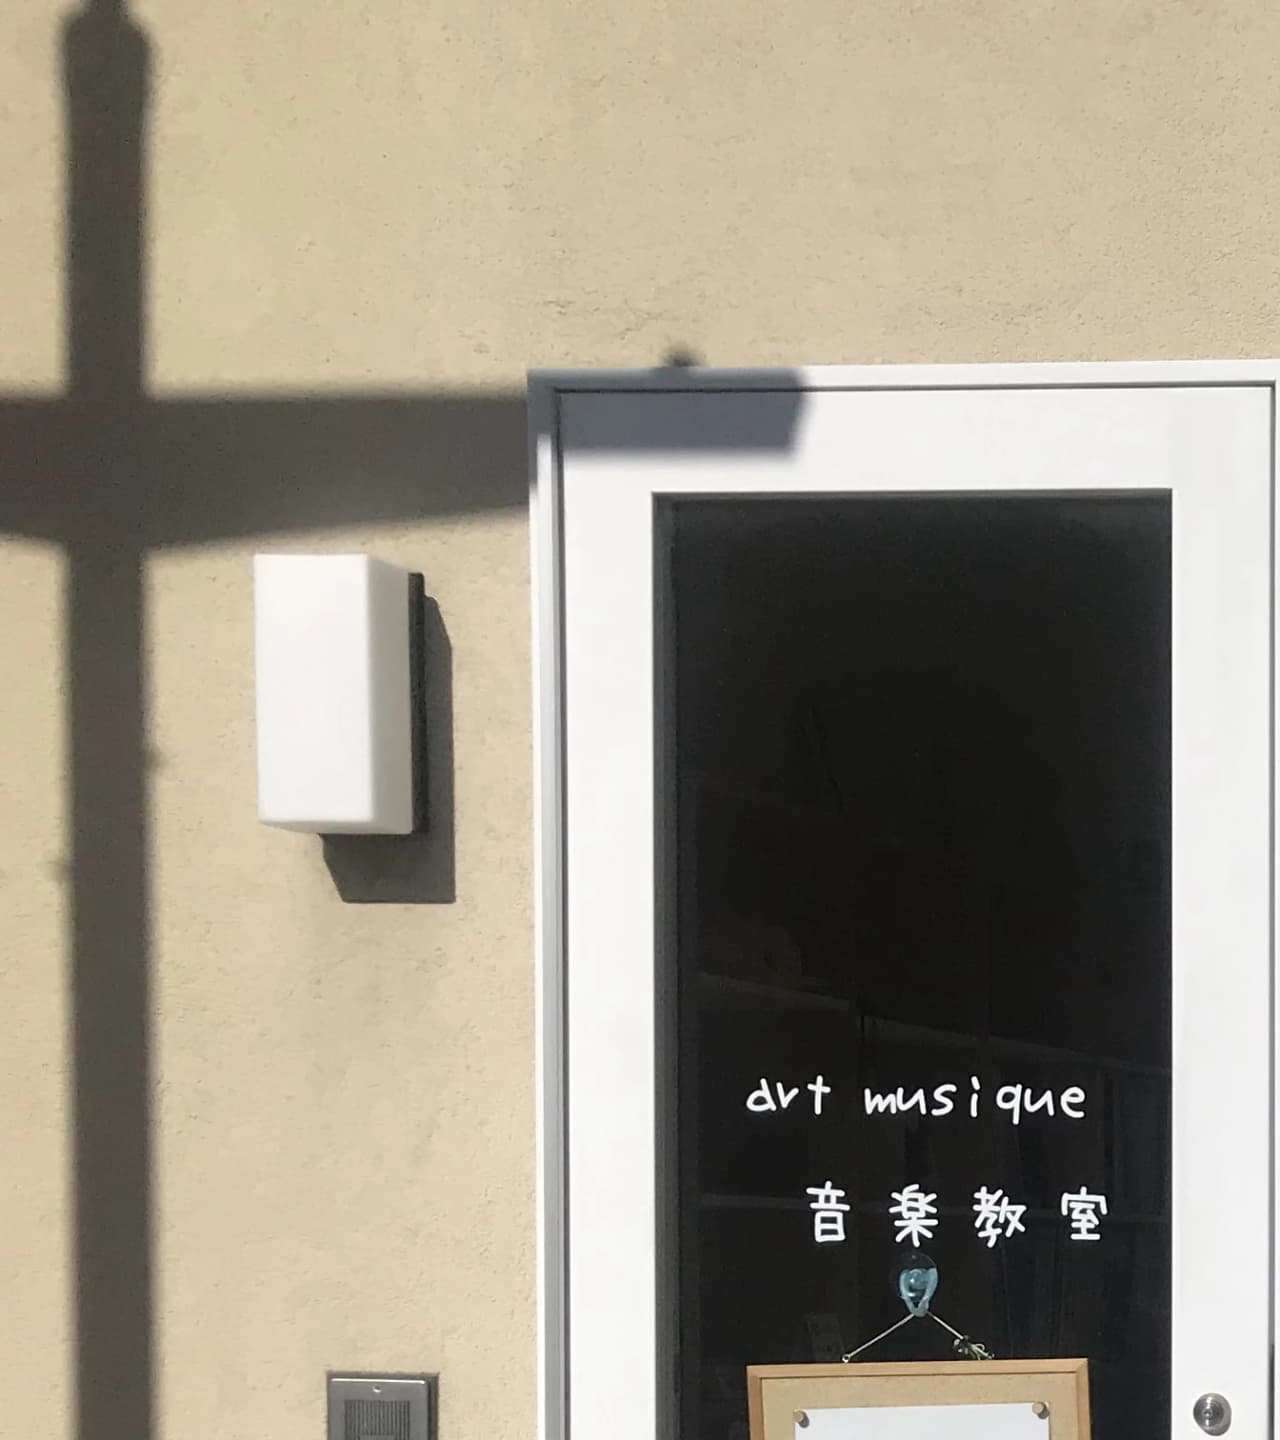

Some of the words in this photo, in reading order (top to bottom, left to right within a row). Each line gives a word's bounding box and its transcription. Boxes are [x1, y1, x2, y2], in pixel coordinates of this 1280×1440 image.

[864, 1076, 1087, 1125] musique
[806, 1180, 1109, 1248] 音楽教室
